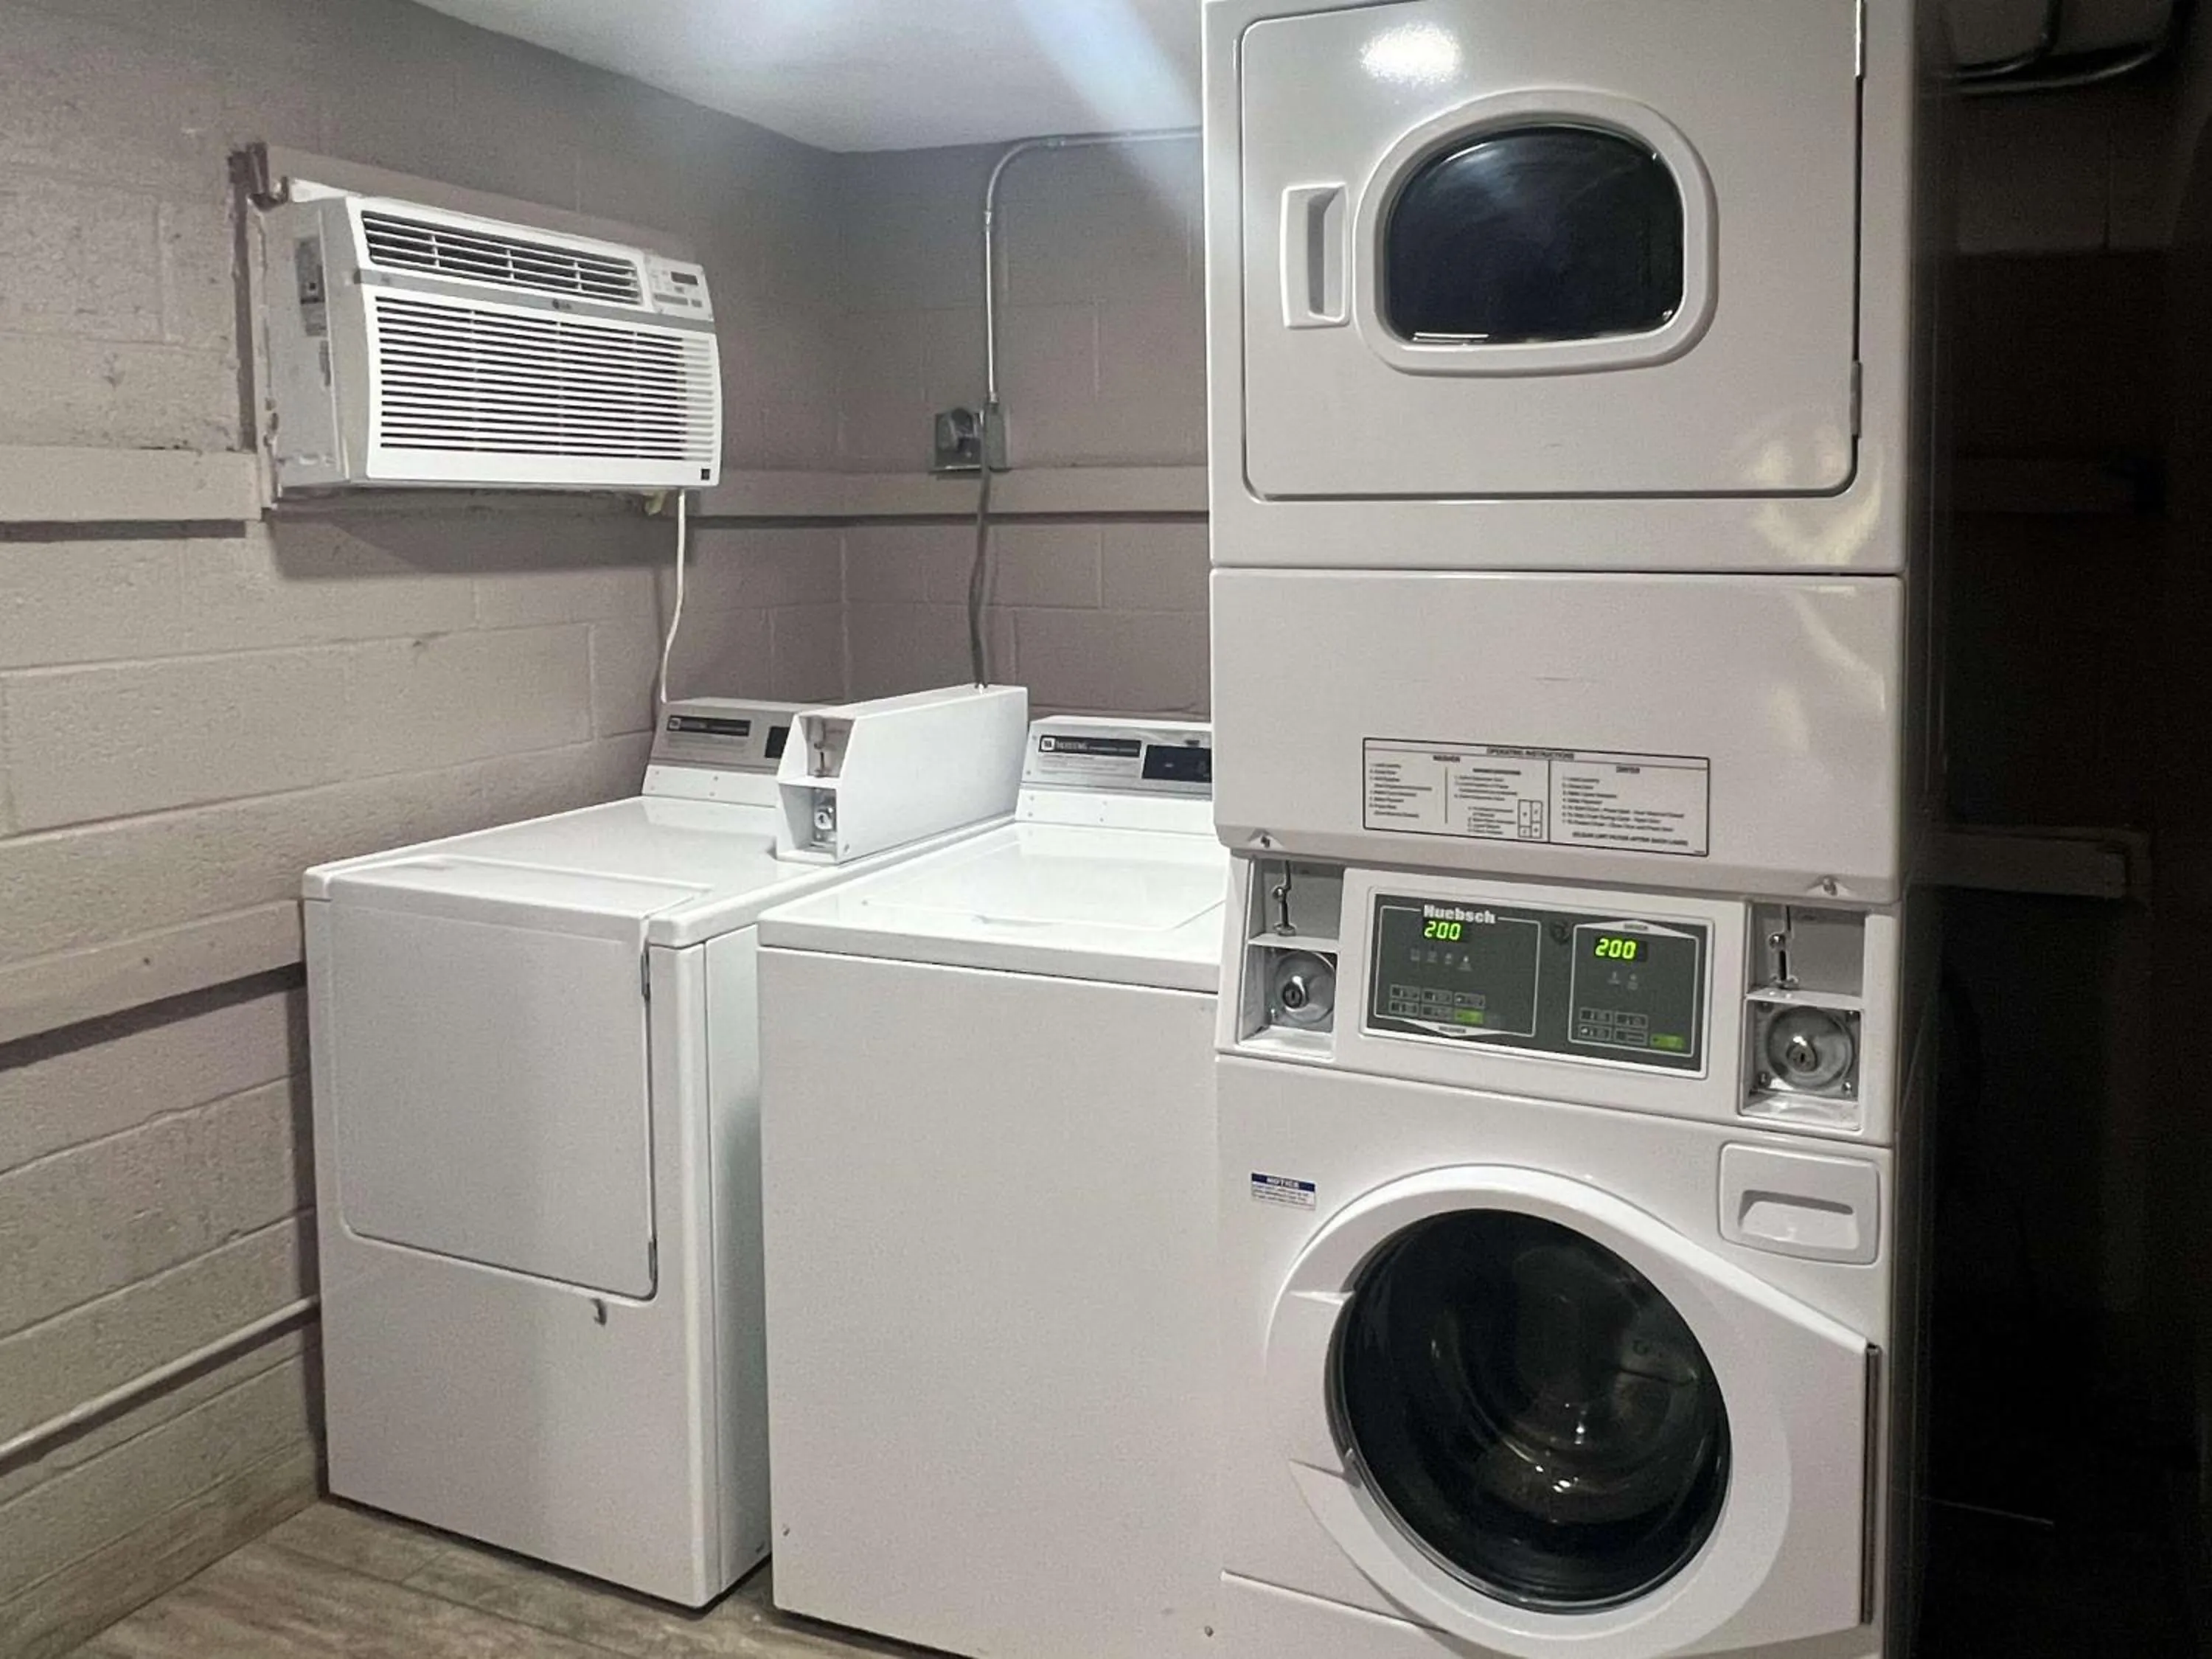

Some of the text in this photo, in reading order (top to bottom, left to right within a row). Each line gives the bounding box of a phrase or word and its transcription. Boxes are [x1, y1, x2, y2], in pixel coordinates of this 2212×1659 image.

[1424, 904, 1496, 924] Huebsch
[1424, 921, 1461, 941] 200
[1595, 937, 1636, 959] 200
